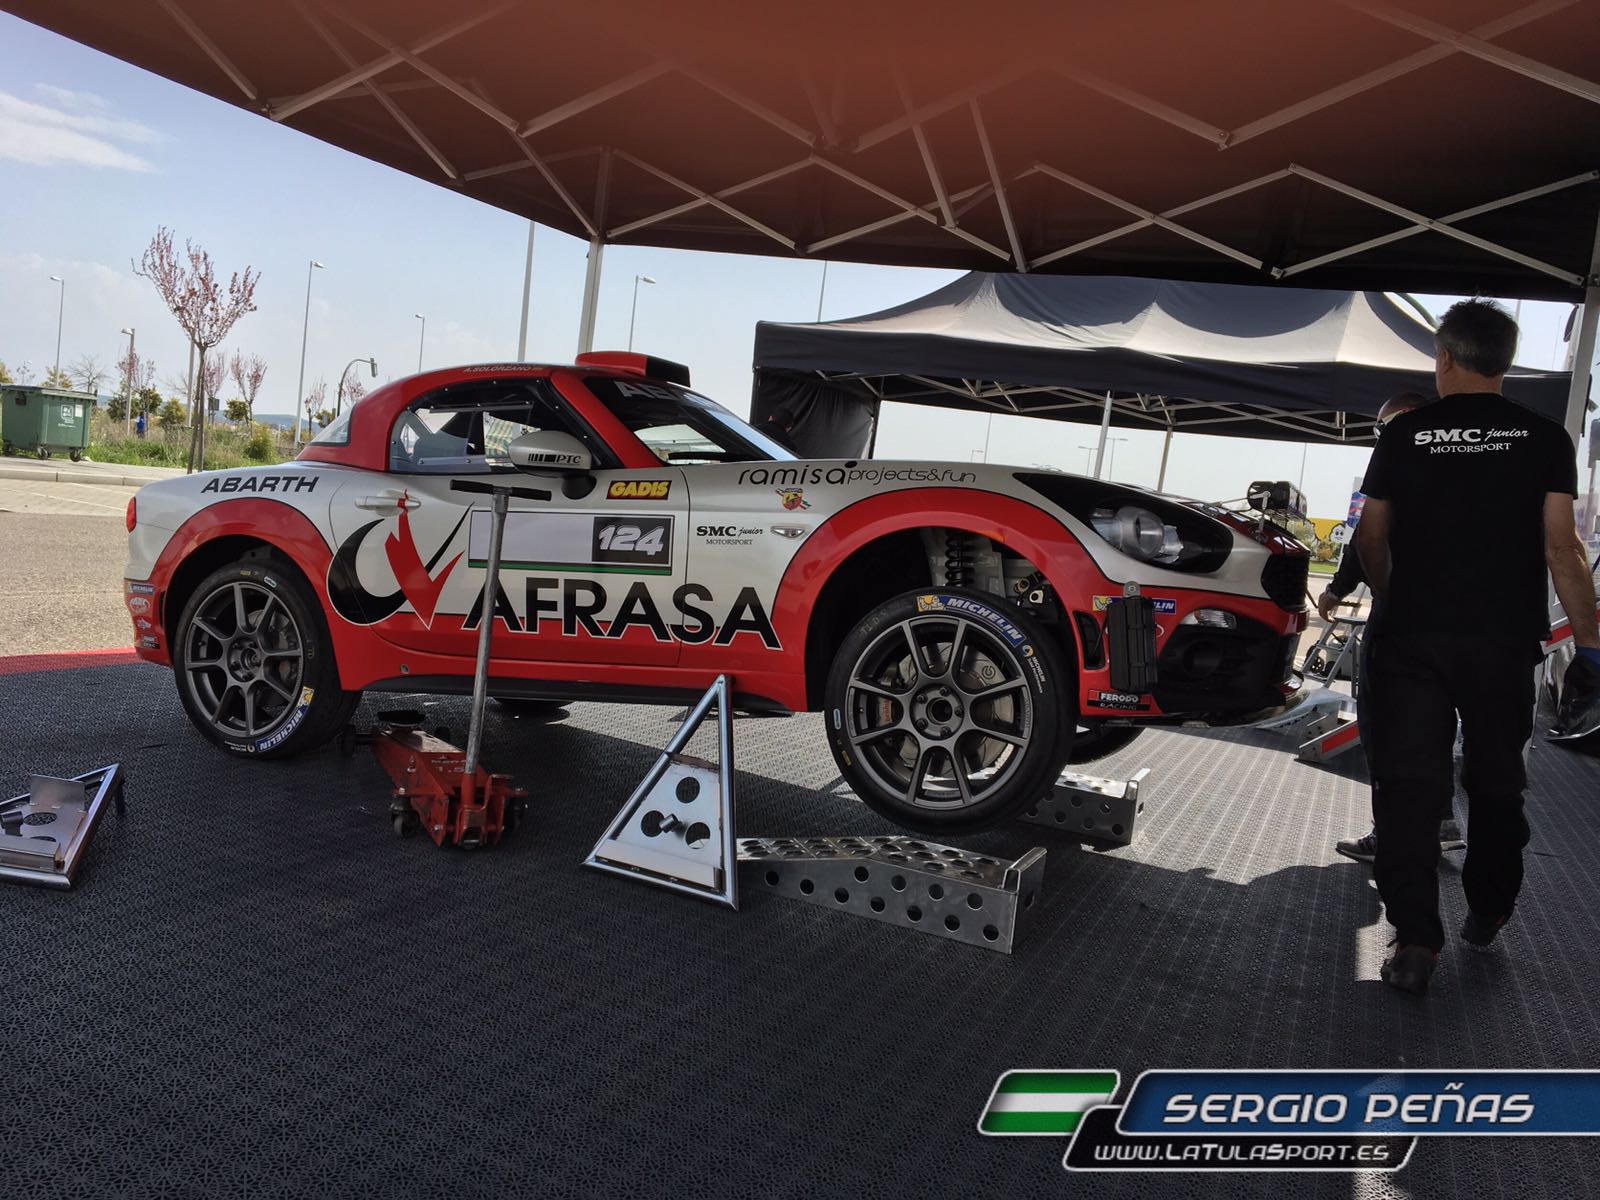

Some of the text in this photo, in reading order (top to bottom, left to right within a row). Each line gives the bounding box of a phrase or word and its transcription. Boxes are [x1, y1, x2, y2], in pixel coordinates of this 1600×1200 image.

[1414, 427, 1530, 445] SMC junior
[1430, 442, 1512, 454] MOTORSPORT
[555, 454, 582, 464] PTC
[200, 476, 320, 494] ABARTH
[609, 481, 670, 498] GADIS
[598, 524, 665, 556] 124
[696, 525, 764, 538] SMC junior
[706, 538, 754, 546] MOTORSPORT
[460, 575, 784, 651] AFRASA
[947, 598, 1022, 641] MICHELIN
[1100, 692, 1139, 703] FERODO
[1100, 702, 1137, 710] RACING
[259, 709, 304, 751] MICHELIN
